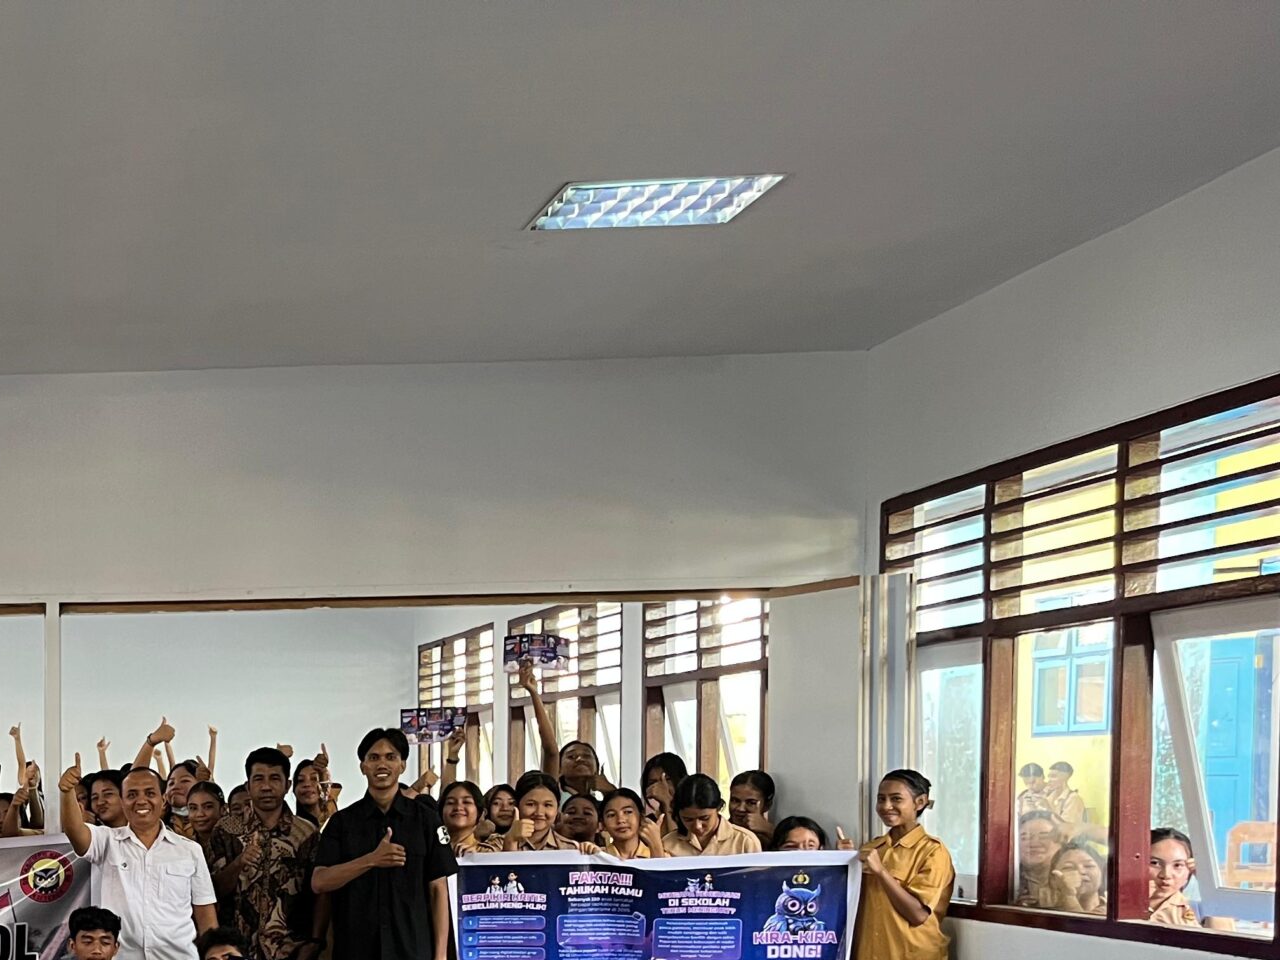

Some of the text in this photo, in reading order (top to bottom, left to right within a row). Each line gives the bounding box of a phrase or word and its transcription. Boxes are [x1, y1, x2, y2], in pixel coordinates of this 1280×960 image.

[569, 871, 633, 886] FAKTA!!!
[559, 886, 643, 897] TAHUKAH KAMU
[462, 893, 547, 903] BERPIKIR KRITIS
[668, 898, 730, 907] DI SEKOLAH
[752, 930, 838, 945] KIRA-KIRA
[767, 945, 822, 959] DONG!
